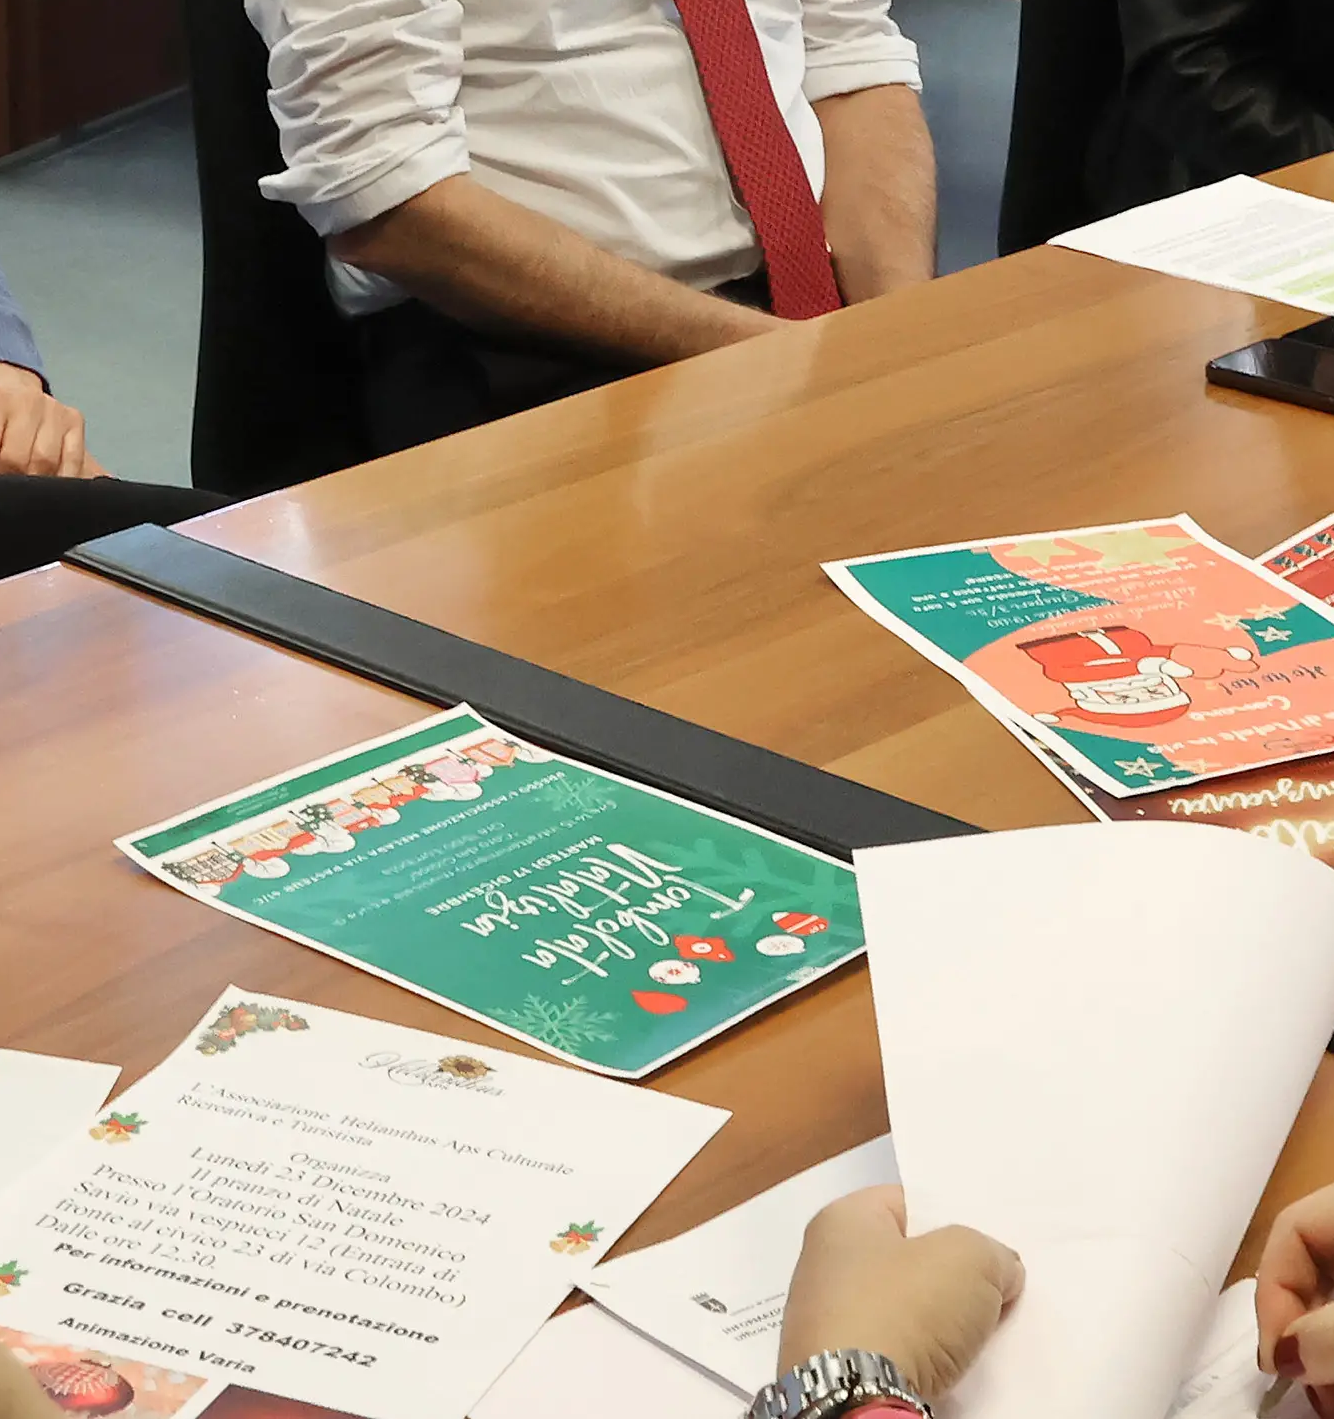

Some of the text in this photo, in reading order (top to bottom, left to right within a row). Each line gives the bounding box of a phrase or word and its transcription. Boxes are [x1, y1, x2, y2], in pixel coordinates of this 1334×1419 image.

[1217, 719, 1304, 742] Natale
[423, 874, 513, 916] DICEMBRE
[460, 841, 683, 938] Natalizia
[522, 874, 756, 986] Tombolata
[191, 1081, 574, 1175] L'Associazione Helianthus Aps Culturale
[289, 1152, 391, 1184] Organizza
[35, 1214, 99, 1240] Dalle
[102, 1236, 142, 1250] ore
[73, 1182, 456, 1283] Savio via vespucci 12 (Entrata di
[92, 1163, 466, 1262] Presso l'Oratorio San Domenico
[210, 1176, 292, 1200] pranzo
[297, 1193, 321, 1208] di
[327, 1199, 404, 1227] Natale
[274, 1166, 307, 1182] 23
[311, 1174, 425, 1210] Dicembre
[429, 1202, 491, 1225] 2024
[54, 1242, 94, 1259] Per
[99, 1253, 250, 1297] informazioni
[274, 1299, 440, 1344] prenotazione
[55, 1198, 466, 1307] fronte al civico 23 di via Colombo)
[58, 1317, 256, 1373] Animazione Varia
[62, 1282, 377, 1368] Grazia cell 378407242
